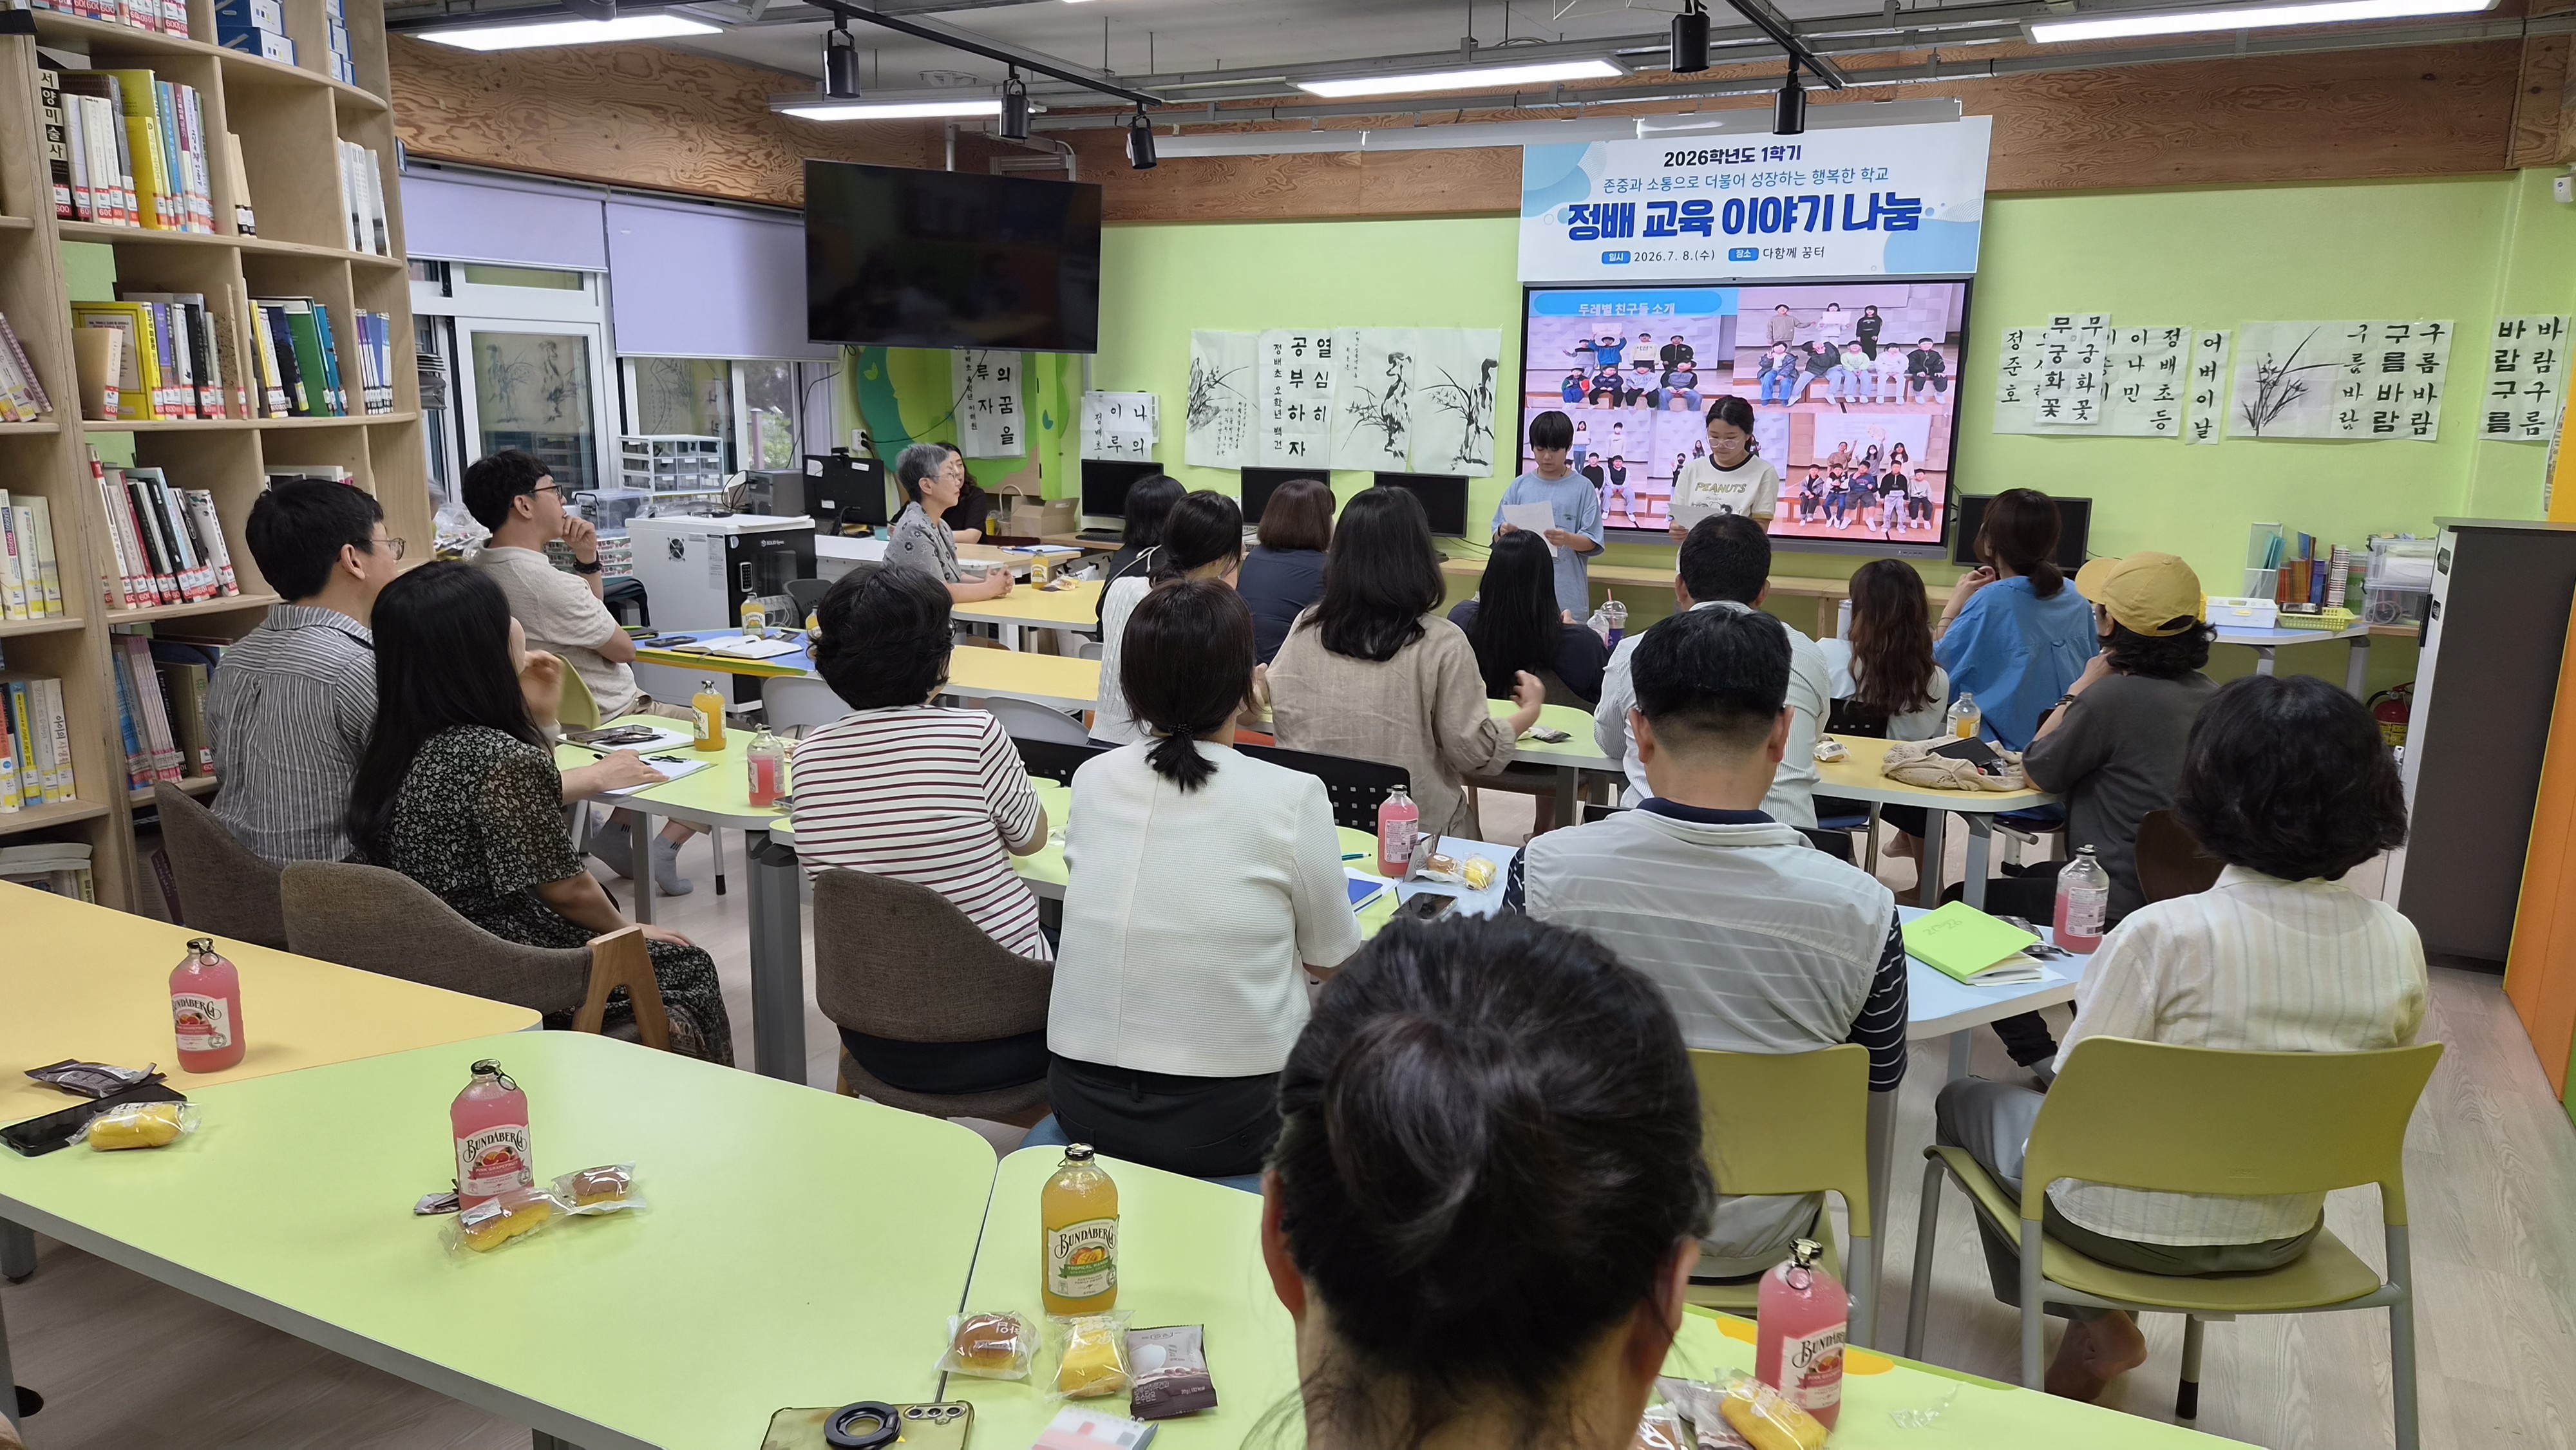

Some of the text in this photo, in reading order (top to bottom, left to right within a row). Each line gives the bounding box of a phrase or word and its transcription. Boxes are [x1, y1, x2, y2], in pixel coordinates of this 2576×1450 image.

[100, 5, 115, 14] 600
[166, 20, 179, 28] 600
[41, 73, 62, 158] 서양미술사
[1663, 145, 1801, 167] 2026학년도 1학기
[1603, 166, 1889, 194] 존중과 소통으로 더불어 성장하는 행복한 학교
[1567, 192, 1922, 241] 정배 교육 이야기 나눔
[1609, 254, 1624, 262] 일시
[1736, 246, 1825, 259] 장소 다함께 꿈터
[1578, 303, 1675, 316] 두레별 친구들 소개
[1273, 344, 1282, 378] 정배초
[2000, 329, 2023, 403] 정준호
[2041, 317, 2072, 417] 무궁화꽃
[2072, 316, 2103, 420] 무궁화꽃
[2124, 329, 2148, 402] 이나민
[1313, 337, 1332, 422] 열심히
[2150, 327, 2181, 430] 정배초등
[2194, 332, 2222, 439] 어버이날
[1274, 386, 1282, 420] 오학년
[1288, 337, 1307, 457] 공부하자
[1107, 403, 1122, 454] 이루
[1133, 404, 1147, 457] 나의
[1695, 482, 1747, 493] PEANUTS
[53, 715, 66, 739] 아이의
[463, 1129, 527, 1163] BUNDABERG
[1054, 1225, 1117, 1259] BUNDABERG
